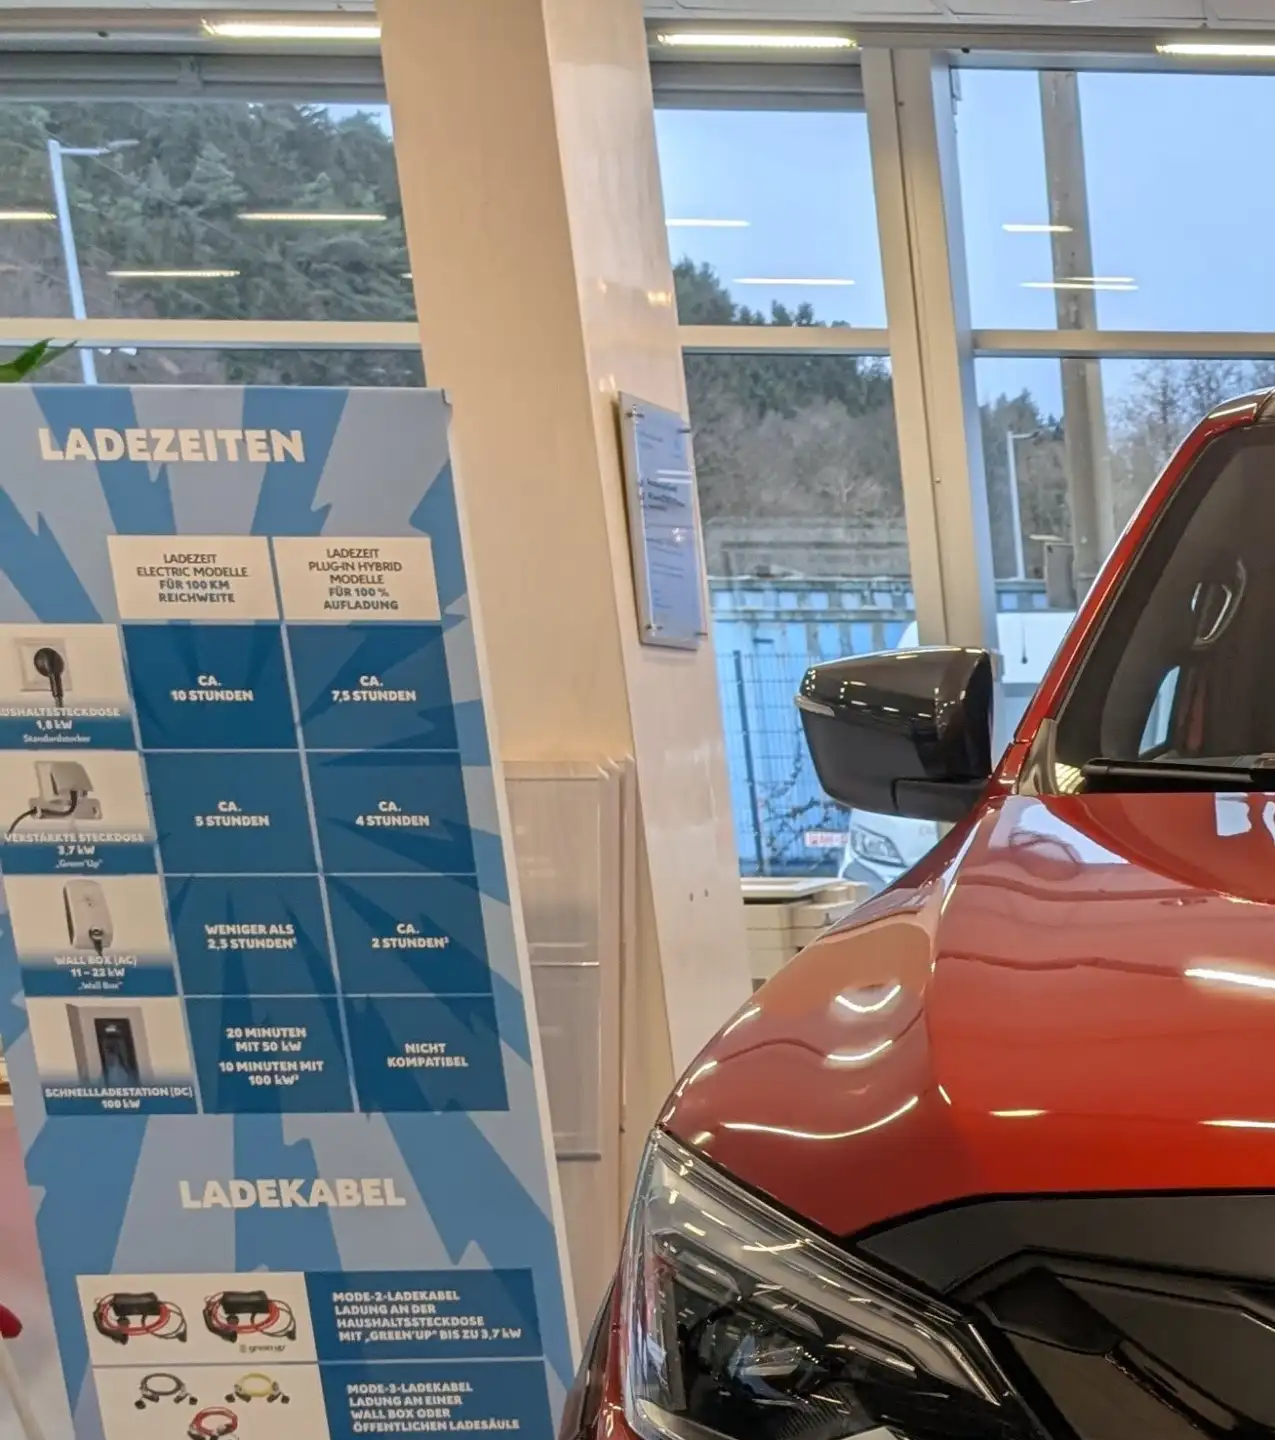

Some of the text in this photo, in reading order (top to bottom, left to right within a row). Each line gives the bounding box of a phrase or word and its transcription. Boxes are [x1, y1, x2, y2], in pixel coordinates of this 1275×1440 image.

[38, 427, 305, 462] LADEZEITEN
[163, 553, 217, 564] LADEZEIT
[326, 548, 380, 559] LADEZEIT
[136, 567, 249, 577] ELECTRIC MODELLE
[308, 561, 402, 572] PLUG-IN HYBRID
[159, 579, 230, 590] FÜR 100 KM
[329, 574, 385, 584] MODELLE
[328, 586, 390, 597] FÜR 100 %
[158, 593, 236, 603] REICHWEITE
[323, 600, 399, 610] AUFLADUNG
[197, 675, 222, 686] CA.
[359, 675, 383, 686] CA.
[170, 690, 253, 701] 10 STUNDEN
[331, 690, 416, 703] 7,5 STUNDEN
[217, 801, 242, 812] CA.
[378, 801, 402, 812] CA.
[195, 816, 270, 826] 5 STUNDEN
[355, 815, 430, 826] 4 STUNDEN
[204, 924, 295, 935] WENIGER ALS
[396, 923, 420, 934] CA.
[208, 939, 229, 951] 2,5
[372, 938, 382, 949] 2
[226, 1027, 307, 1039] 20 MINUTEN
[235, 1041, 302, 1052] MIT 50 kW
[404, 1043, 446, 1054] NICHT
[219, 1060, 324, 1072] 10 MINUTEN MIT
[387, 1056, 469, 1067] KOMPATIBEL
[248, 1075, 272, 1086] 100
[179, 1178, 406, 1209] LADEKABEL
[333, 1290, 460, 1302] MODE-2-LADEKABEL
[334, 1303, 437, 1315] LADUNG AN DER
[336, 1315, 485, 1328] HAUSHALTSSTECKDOSE
[339, 1331, 362, 1342] MIT
[439, 1329, 461, 1340] BIS
[462, 1329, 478, 1339] ZU
[480, 1329, 501, 1340] 3,7
[501, 1328, 522, 1338] kW
[347, 1382, 473, 1394] MODE-3-LADEKABEL
[349, 1395, 463, 1407] LADUNG AN EINER
[351, 1408, 451, 1420] WALL BOX ODER
[353, 1418, 520, 1433] ÖFFENTLICHEN LADESÄULE
